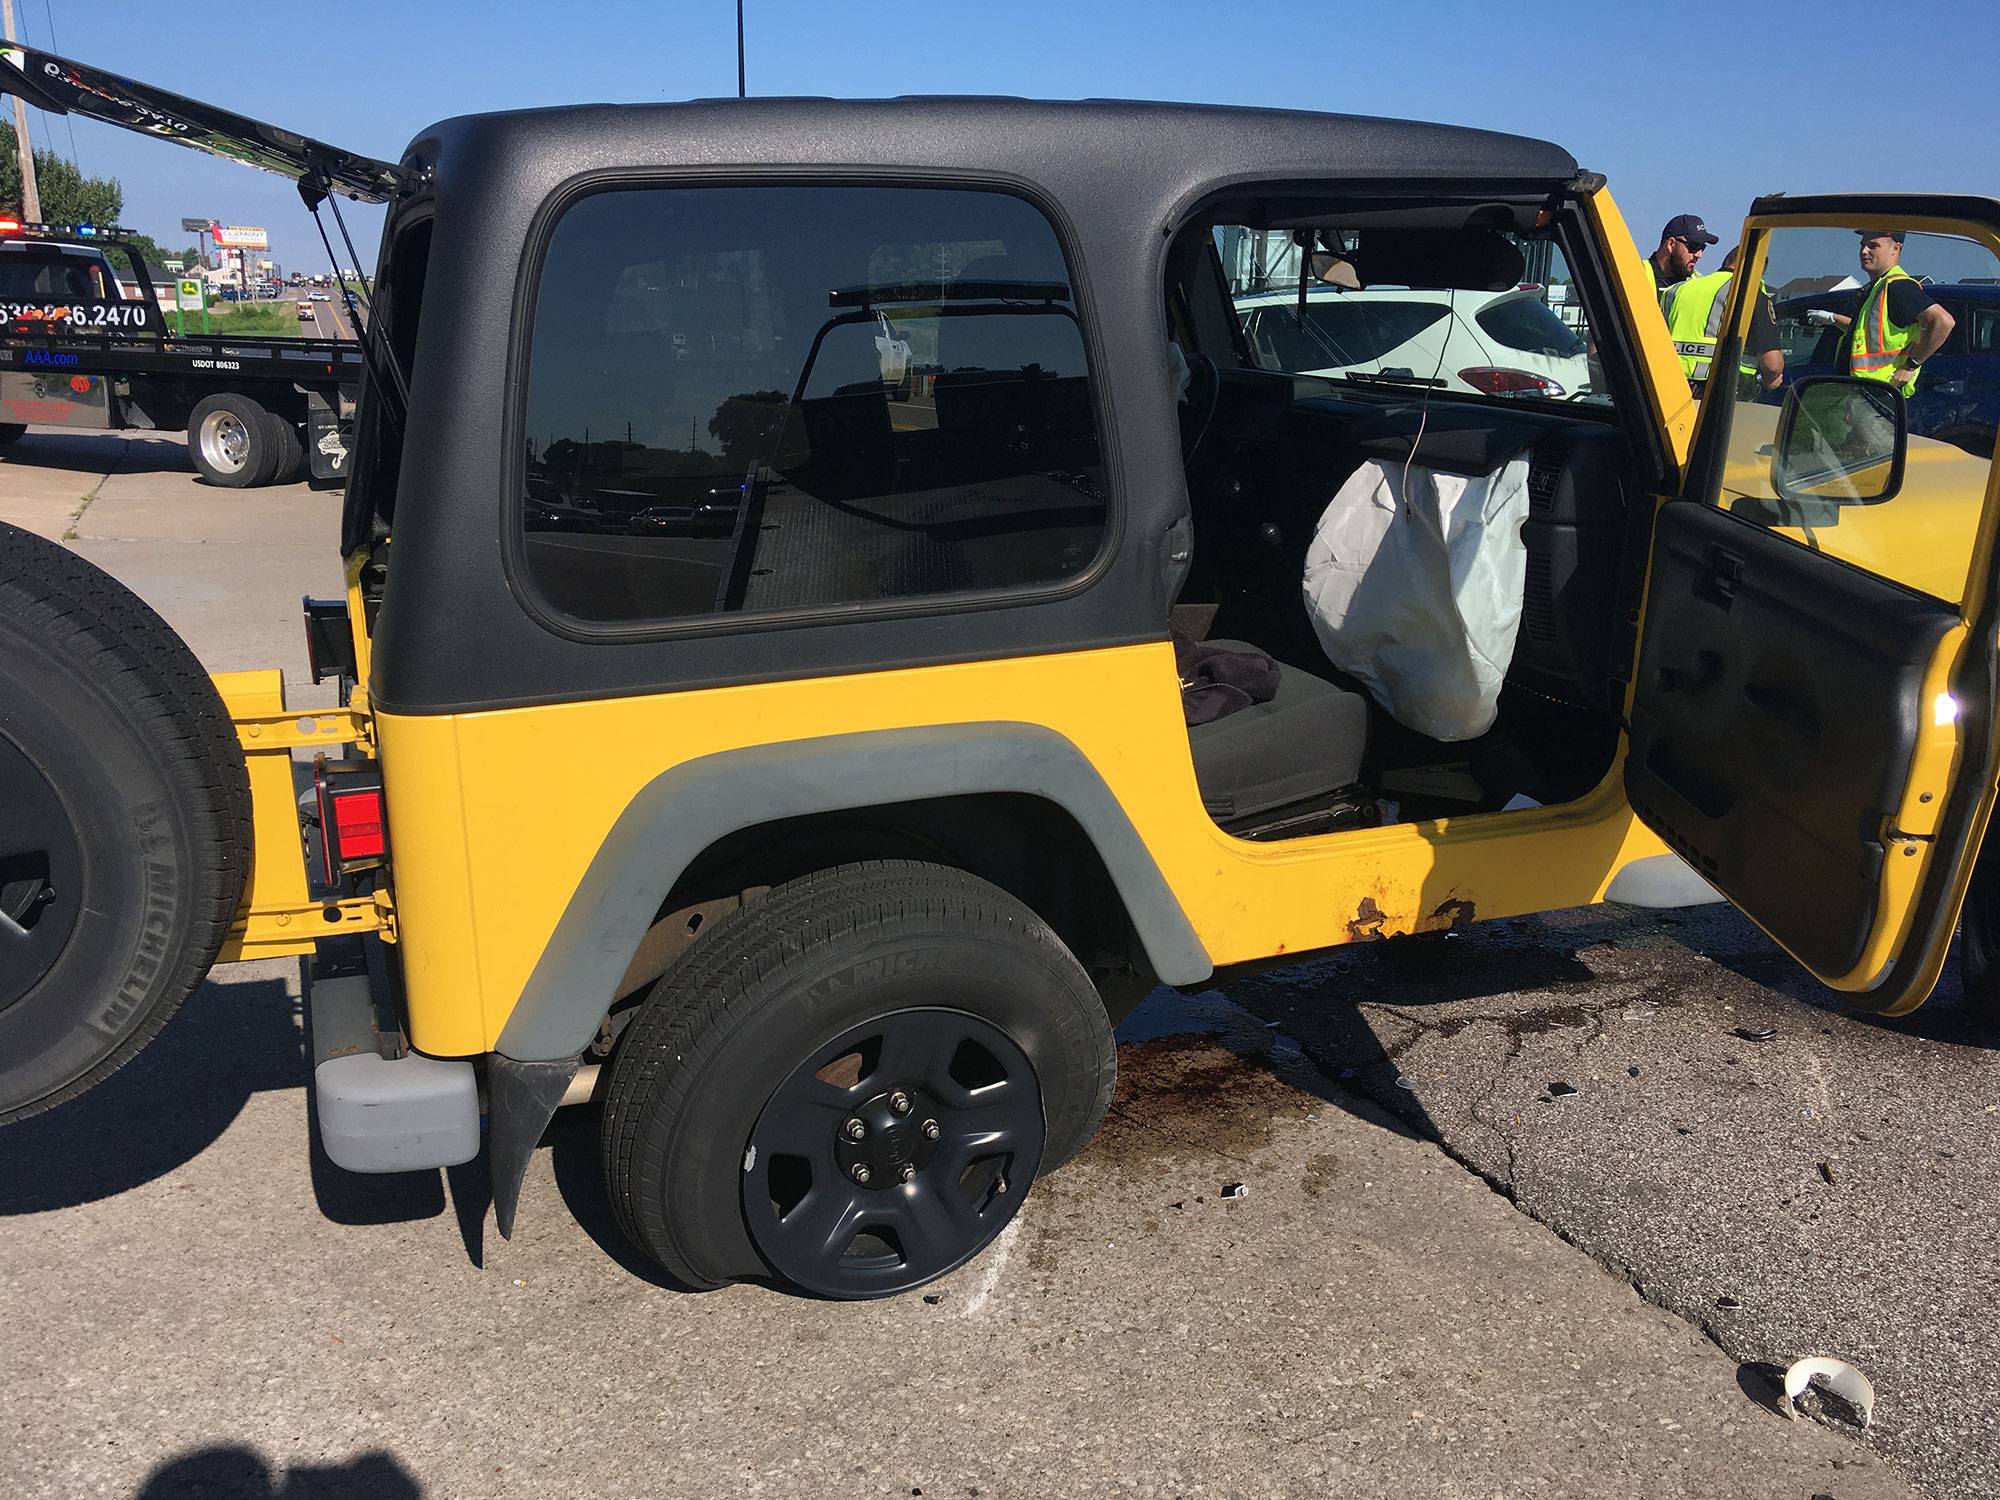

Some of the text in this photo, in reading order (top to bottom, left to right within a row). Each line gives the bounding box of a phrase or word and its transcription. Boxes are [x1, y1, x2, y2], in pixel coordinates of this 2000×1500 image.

[1676, 343, 1706, 354] ICE
[25, 350, 79, 365] AAA.com
[192, 359, 240, 370] USDOT 806323
[100, 862, 176, 1033] MICHELIN
